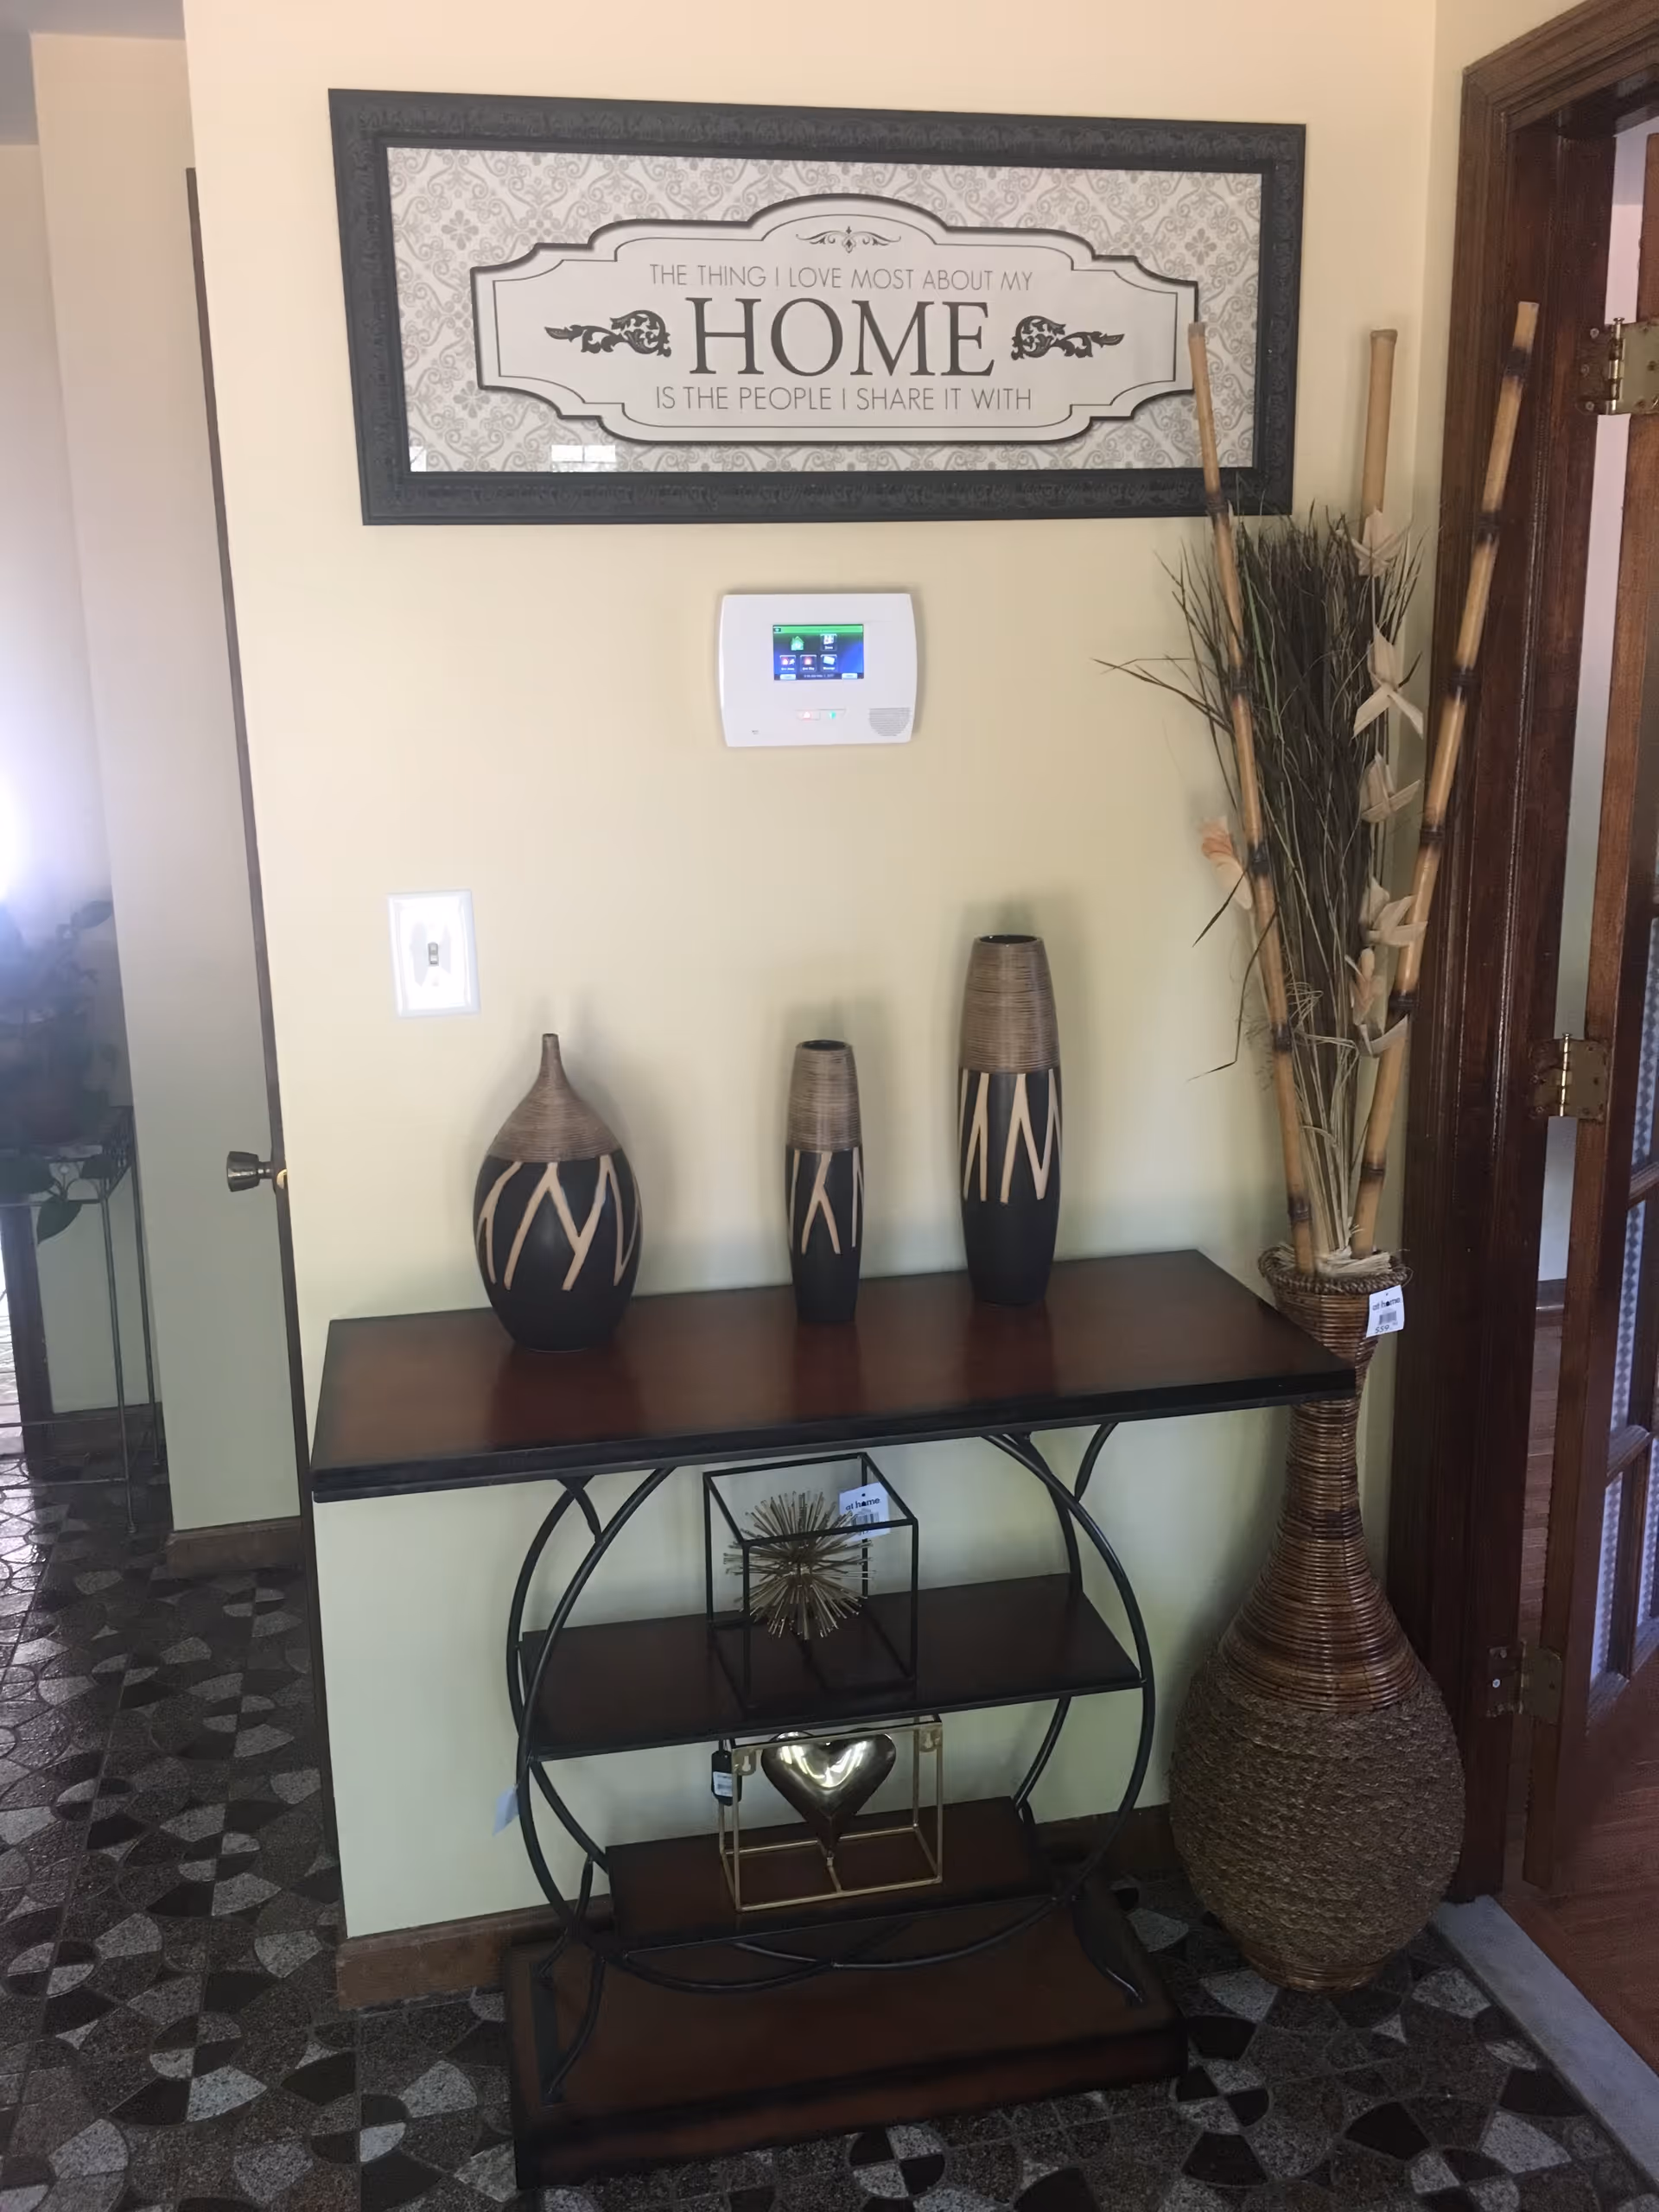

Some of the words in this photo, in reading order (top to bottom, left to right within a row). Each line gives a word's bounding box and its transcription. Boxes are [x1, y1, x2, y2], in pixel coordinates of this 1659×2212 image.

[650, 264, 687, 285] THE
[697, 264, 766, 287] THING
[790, 266, 842, 289] LOVE
[851, 268, 914, 289] MOST
[922, 270, 993, 291] ABOUT
[1001, 271, 1033, 291] MY
[685, 296, 995, 377] HOME
[656, 385, 676, 409] IS
[683, 386, 728, 410] THE
[740, 386, 831, 410] PEOPLE
[856, 387, 934, 410] SHARE
[944, 387, 961, 410] IT
[971, 387, 1031, 410] WITH
[855, 1497, 880, 1509] home
